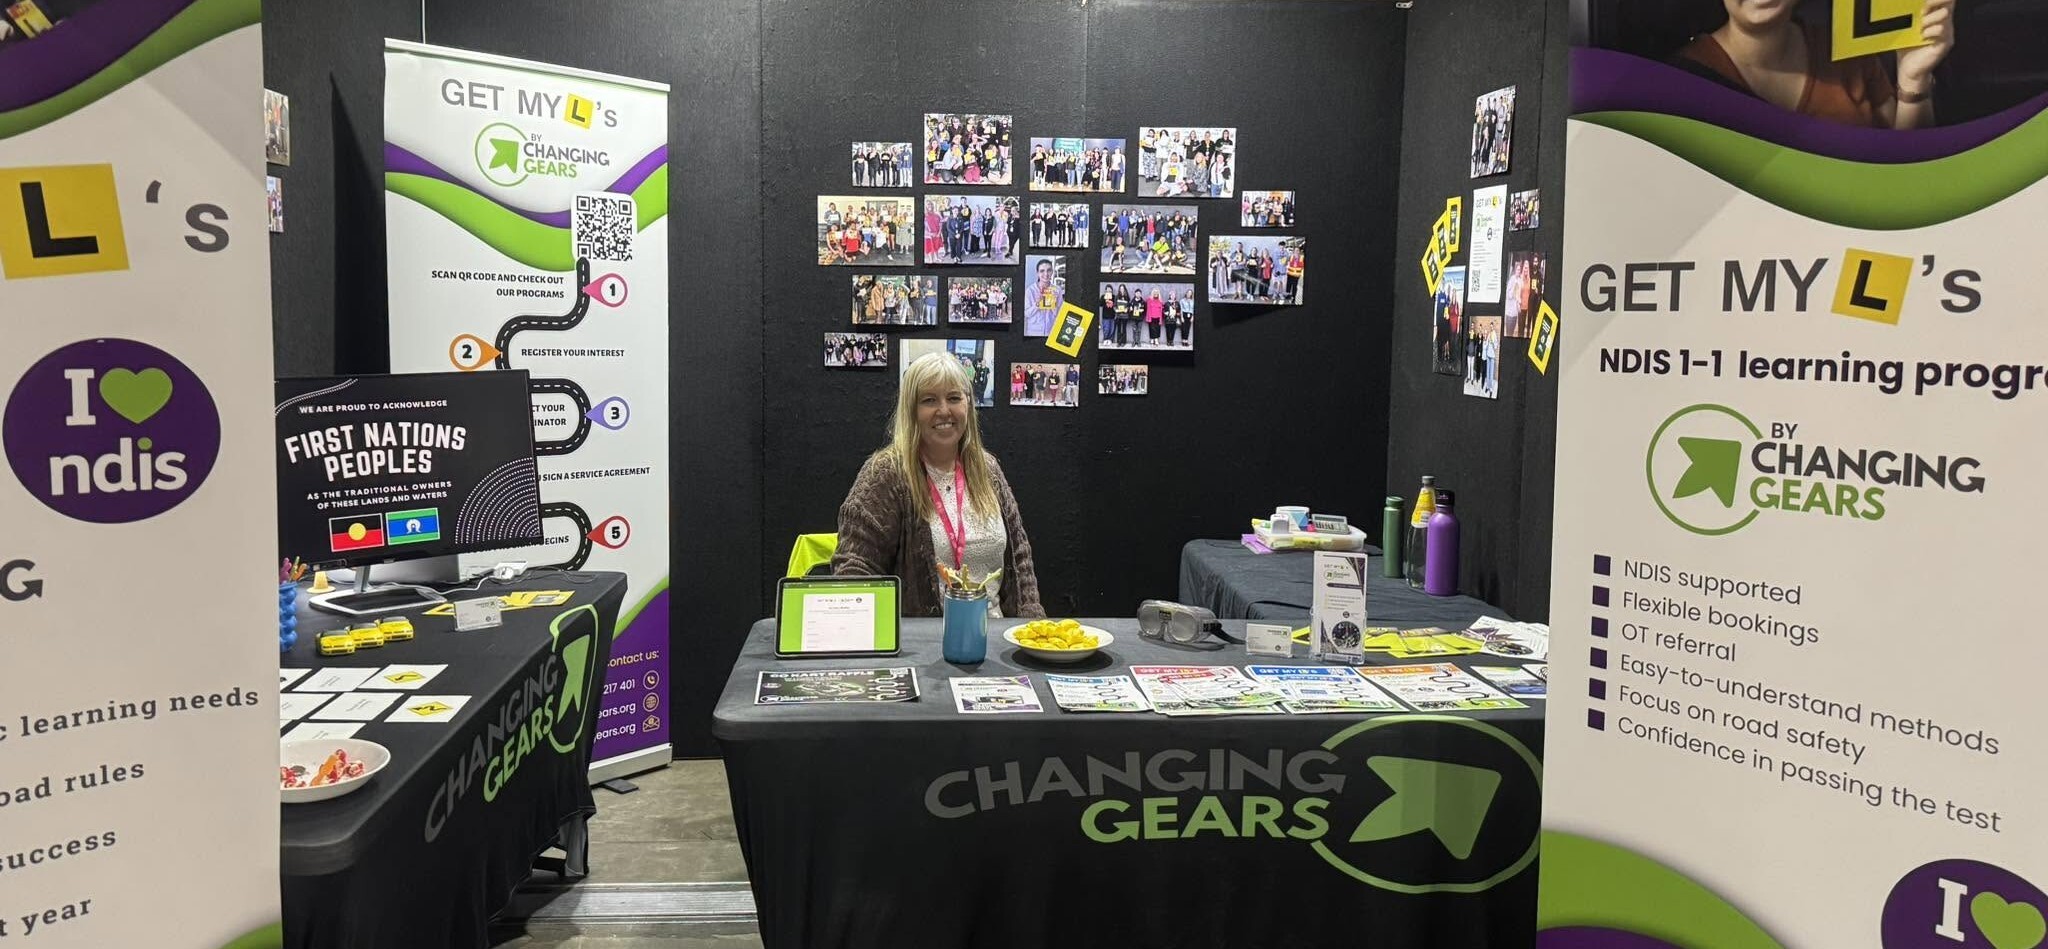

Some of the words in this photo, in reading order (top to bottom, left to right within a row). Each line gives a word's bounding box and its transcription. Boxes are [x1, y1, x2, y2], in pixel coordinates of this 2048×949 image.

[441, 78, 504, 111] GET
[518, 89, 562, 119] MY
[523, 141, 610, 167] CHANGING
[531, 133, 542, 142] BY
[523, 161, 578, 178] GEARS
[431, 270, 457, 279] SCAN
[458, 271, 472, 281] QR
[473, 272, 496, 281] CODE
[497, 273, 516, 282] AND
[517, 274, 546, 284] CHECK
[547, 276, 564, 284] OUT
[496, 288, 515, 297] OUR
[516, 289, 564, 298] PROGRAMS
[609, 284, 616, 296] 1
[1580, 261, 1696, 313] GET
[1722, 258, 1830, 313] MY
[462, 344, 472, 359] 2
[521, 348, 562, 357] REGISTER
[563, 349, 586, 357] YOUR
[586, 349, 625, 357] INTEREST
[1600, 348, 1671, 375] NDIS
[1679, 348, 1722, 378] 1-1
[1739, 350, 1904, 393] learning
[1915, 361, 2048, 400] progr
[64, 369, 96, 426] I
[299, 405, 315, 414] WE
[316, 404, 334, 413] ARE
[336, 403, 366, 412] PROUD
[368, 402, 380, 411] TO
[382, 400, 447, 410] ACKNOWLEDGE
[541, 404, 565, 412] YOUR
[611, 407, 620, 420] 3
[284, 424, 354, 464] FIRST
[364, 421, 467, 451] NATIONS
[1771, 422, 1798, 439] BY
[49, 437, 188, 496] ndis
[324, 449, 432, 482] PEOPLES
[542, 473, 563, 482] SIGN
[563, 472, 570, 480] A
[570, 470, 603, 480] SERVICE
[604, 466, 651, 477] AGREEMENT
[1750, 441, 1986, 494] CHANGING
[307, 492, 320, 500] AS
[322, 490, 342, 499] THE
[344, 485, 409, 497] TRADITIONAL
[412, 480, 452, 490] OWNERS
[317, 501, 329, 510] OF
[330, 498, 359, 508] THESE
[361, 495, 390, 505] LANDS
[391, 494, 410, 502] AND
[412, 490, 448, 501] WATERS
[1749, 476, 1886, 521] GEARS
[611, 526, 621, 539] 5
[1624, 559, 1672, 584] NDIS
[1678, 568, 1801, 606] supported
[1623, 591, 1701, 622] Flexible
[1708, 605, 1820, 647] bookings
[608, 652, 642, 667] ontact
[646, 650, 660, 661] us:
[1621, 623, 1649, 643] OT
[1656, 629, 1736, 662] referral
[603, 683, 618, 695] 217
[620, 679, 635, 691] 401
[1620, 653, 1862, 724] Easy-to-understand
[1869, 709, 2001, 755] methods
[20, 698, 158, 737] learning
[168, 686, 260, 713] needs
[1619, 684, 1681, 716] Focus
[1687, 702, 1716, 723] on
[1722, 711, 1779, 740] road
[1786, 724, 1866, 764] safety
[424, 654, 558, 843] CHANGING
[483, 694, 554, 803] GEARS
[594, 724, 636, 744] ears.org
[64, 760, 146, 794] rules
[924, 748, 1347, 819] CHANGING
[1618, 716, 1746, 765] Confidence
[1752, 749, 1774, 773] in
[1781, 756, 1882, 807] passing
[1891, 785, 1937, 815] the
[1945, 798, 2002, 833] test
[1081, 795, 1330, 843] GEARS
[0, 829, 118, 873] uccess
[21, 897, 93, 936] year
[1935, 877, 1968, 943] I
